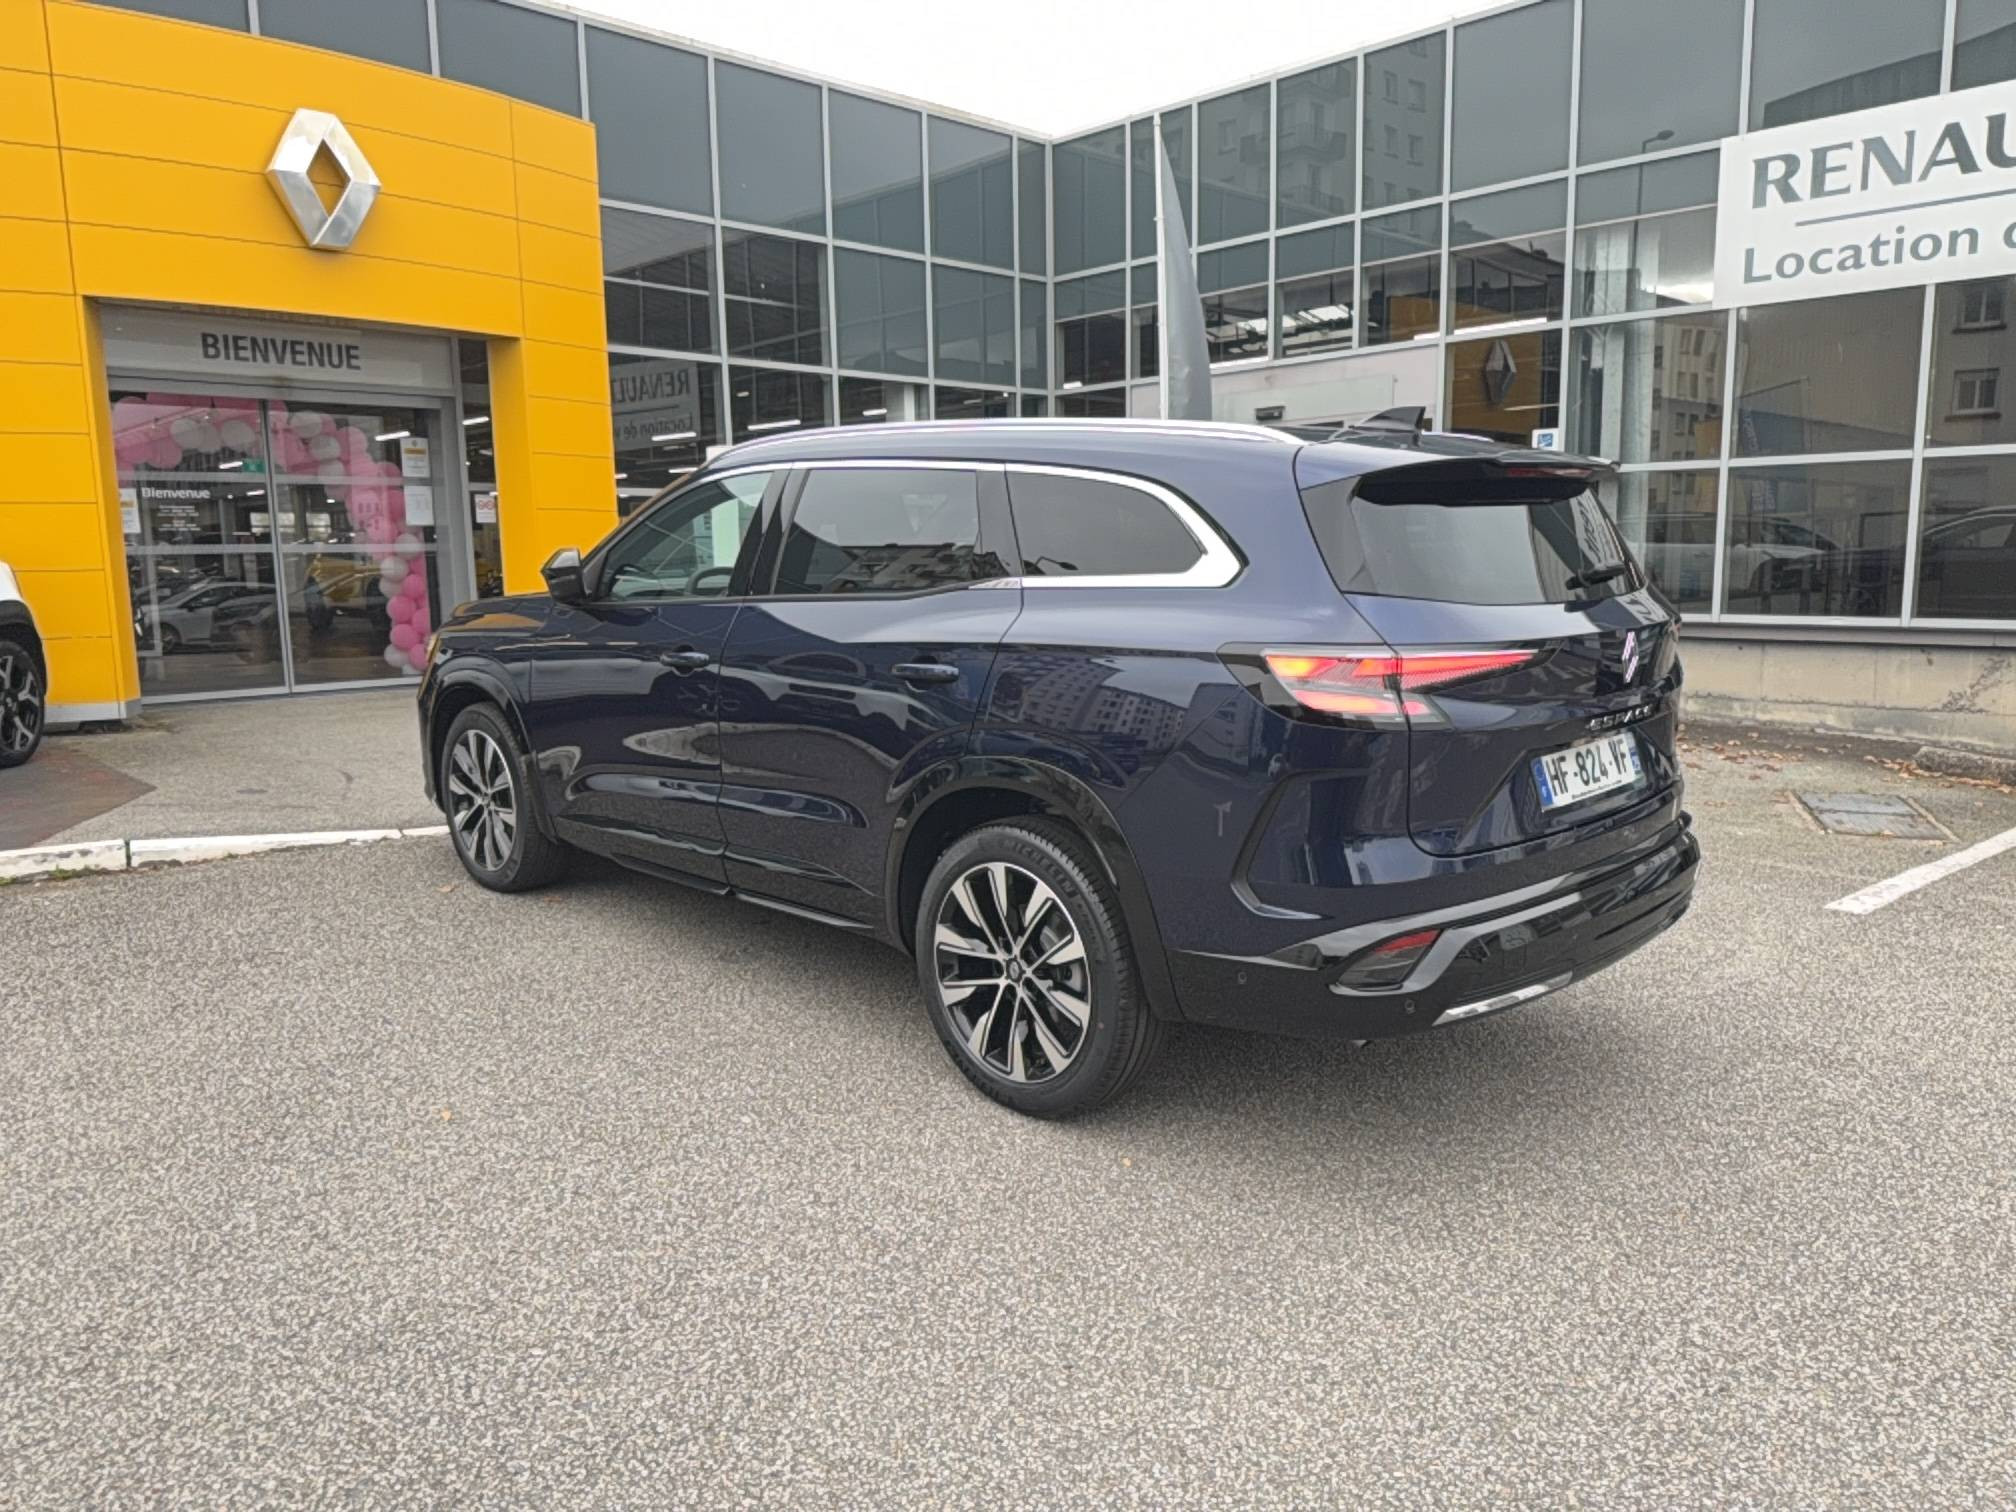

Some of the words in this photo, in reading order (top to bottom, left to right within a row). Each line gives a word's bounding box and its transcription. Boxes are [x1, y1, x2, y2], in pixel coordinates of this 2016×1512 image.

[1744, 225, 1979, 284] Location
[201, 332, 361, 371] BIENVENUE
[141, 486, 211, 499] Bienvenue
[1588, 704, 1652, 731] ESPACE
